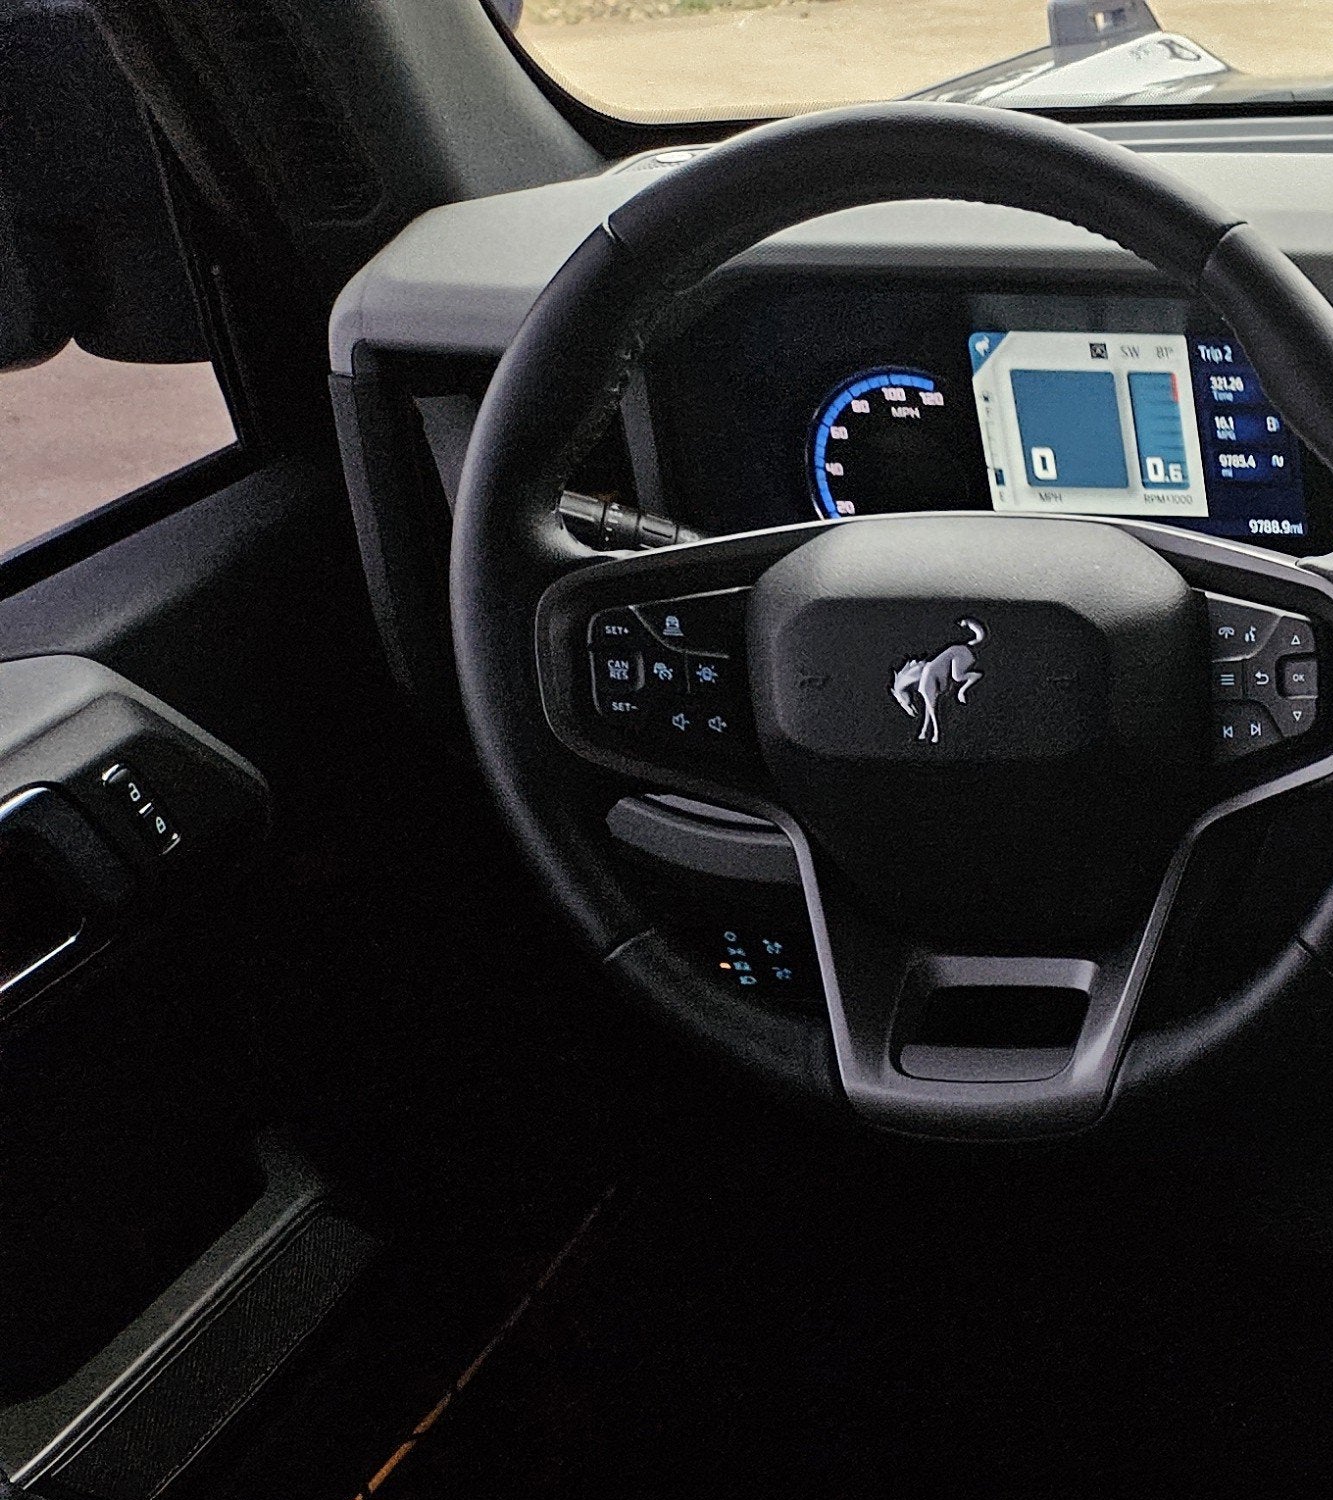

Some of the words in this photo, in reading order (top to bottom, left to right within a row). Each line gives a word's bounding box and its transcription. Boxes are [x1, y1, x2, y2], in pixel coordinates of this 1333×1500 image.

[880, 386, 907, 402] 100
[918, 391, 945, 406] 120
[890, 406, 921, 419] MPH
[829, 425, 849, 440] 60
[824, 462, 845, 476] 40
[1031, 446, 1058, 481] 0
[1145, 456, 1184, 483] 0.6
[836, 500, 855, 515] 20
[607, 659, 630, 670] CAN
[609, 669, 630, 680] RES
[1292, 673, 1306, 683] OK
